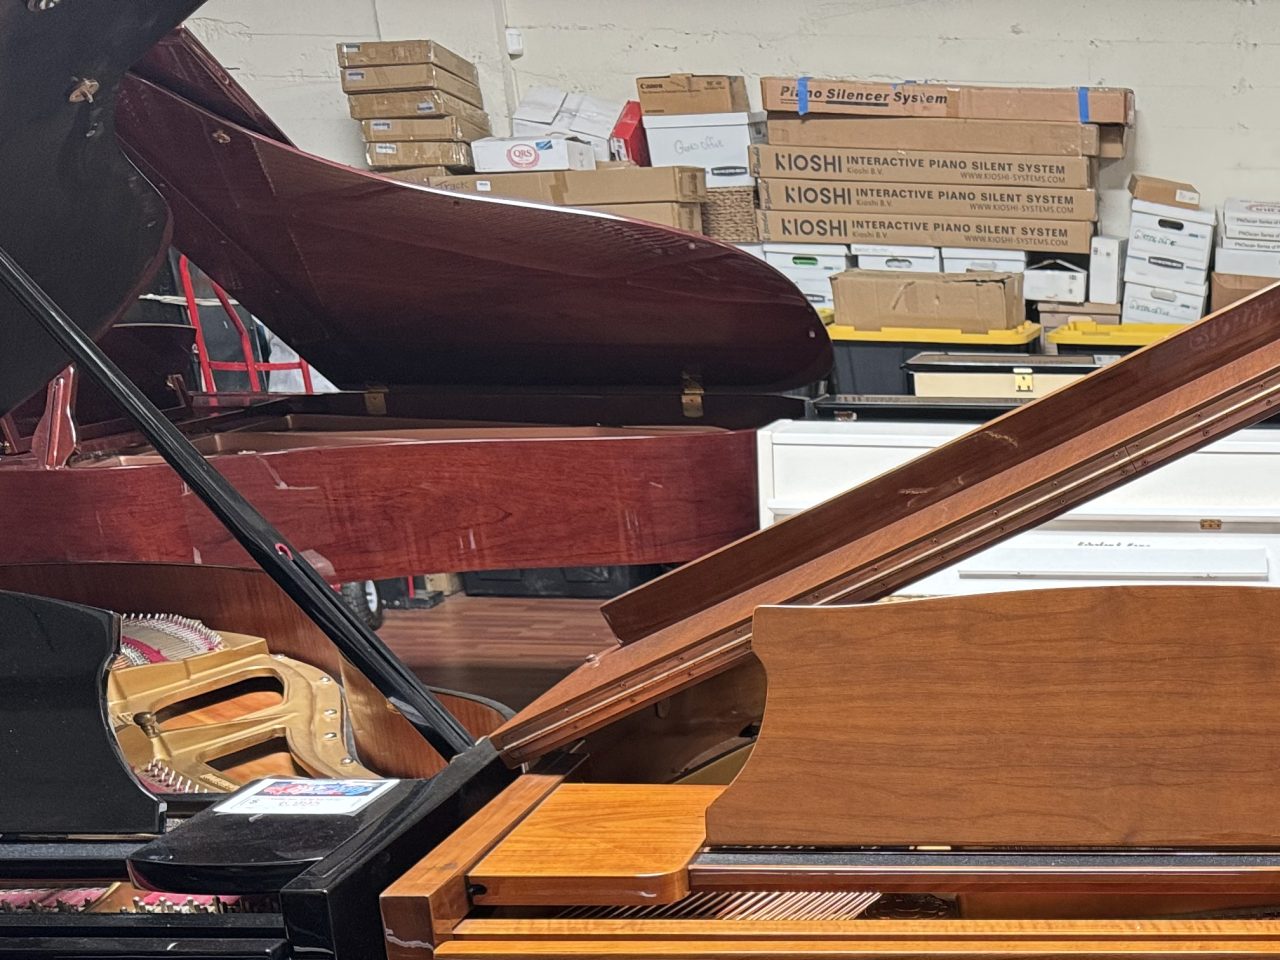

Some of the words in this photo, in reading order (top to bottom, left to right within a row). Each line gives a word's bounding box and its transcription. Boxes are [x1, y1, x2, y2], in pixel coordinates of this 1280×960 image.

[826, 88, 890, 102] Silencer
[513, 150, 533, 159] QRS
[775, 153, 842, 173] KIOSHI
[846, 155, 924, 168] INTERACTIVE
[929, 159, 967, 170] PIANO
[971, 161, 1013, 172] SILENT
[1017, 163, 1065, 174] SYSTEM
[847, 167, 869, 175] Kioshi
[960, 172, 1066, 183] WWW.KIOSHI-SYSTEMS.COM
[785, 185, 852, 205] KIOSHI
[856, 187, 933, 199] INTERACTIVE
[938, 190, 976, 201] PIANO
[980, 192, 1022, 203] SILENT
[1026, 194, 1074, 205] SYSTEM
[856, 199, 879, 207] Kioshi
[969, 203, 1074, 214] WWW.KIOSHI-SYSTEMS.COM
[781, 218, 848, 237] KIOSHI
[852, 220, 929, 231] INTERACTIVE
[933, 223, 971, 233] PIANO
[975, 224, 1017, 235] SILENT
[1021, 227, 1068, 238] SYSTEM
[852, 231, 875, 239] Kioshi
[964, 235, 1069, 246] WWW.KIOSHI-SYSTEMS.COM
